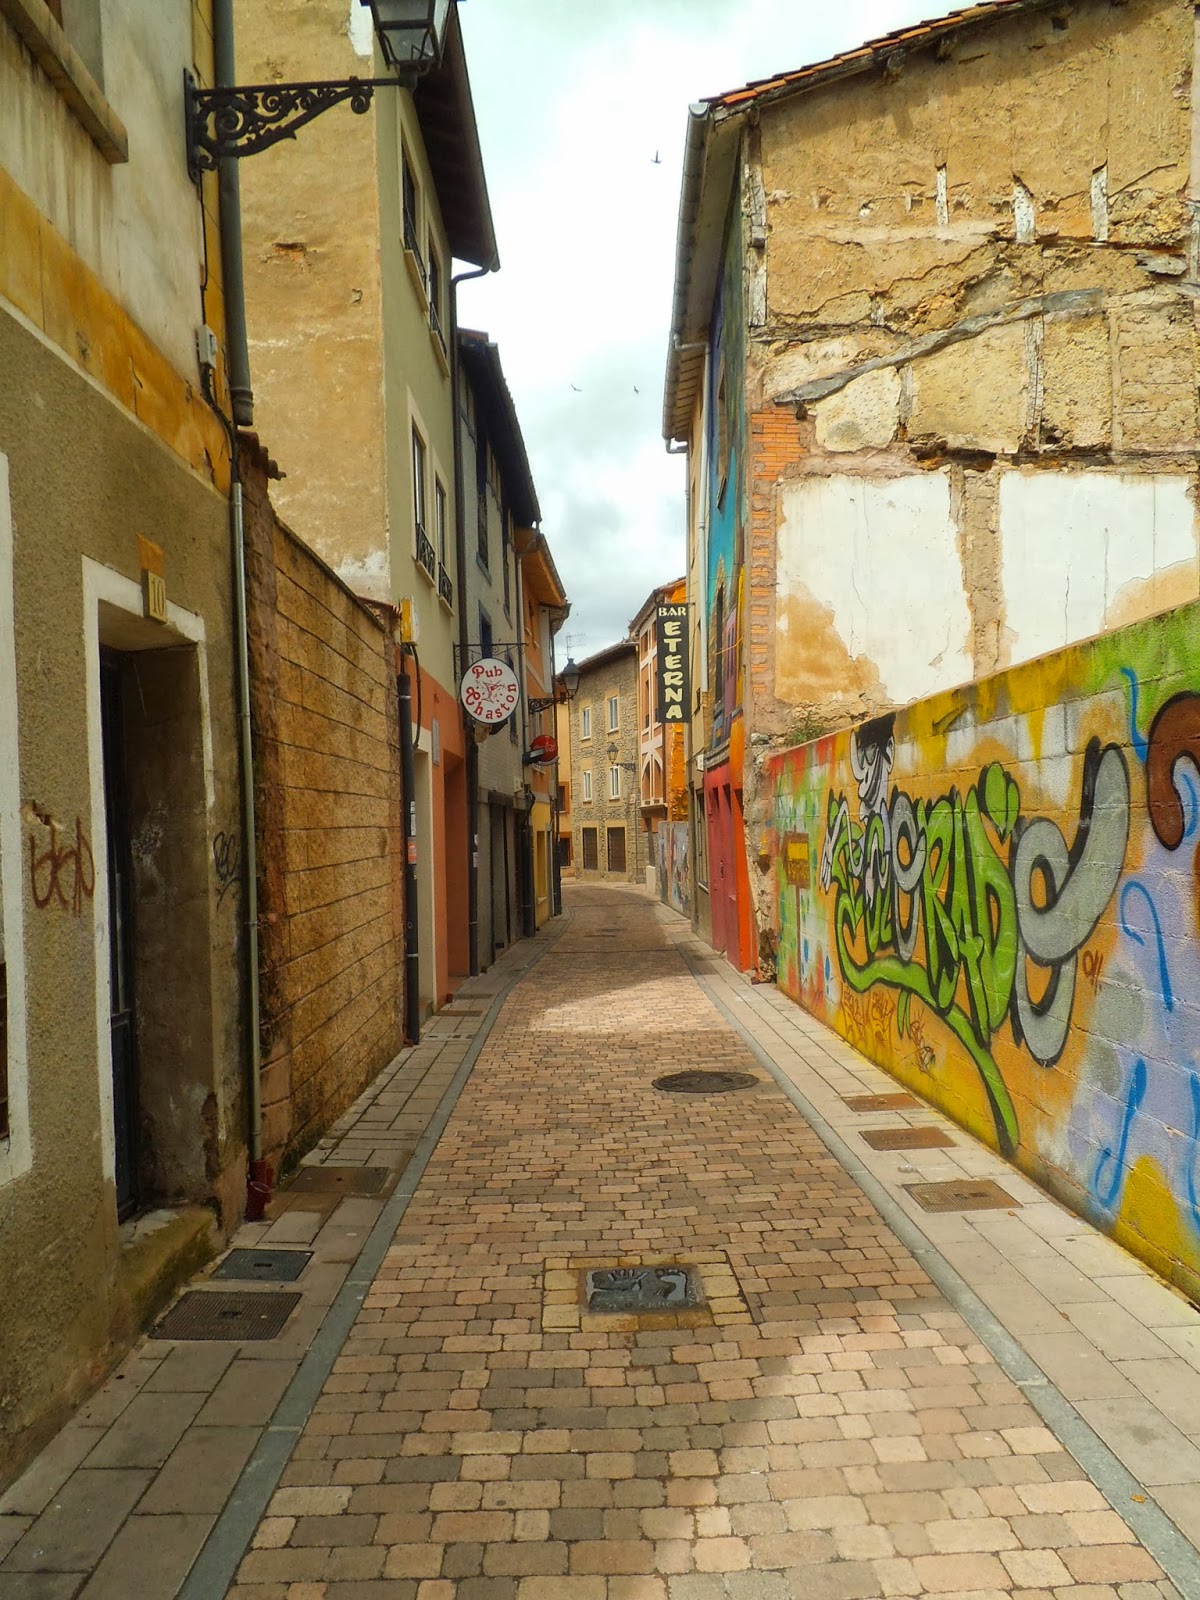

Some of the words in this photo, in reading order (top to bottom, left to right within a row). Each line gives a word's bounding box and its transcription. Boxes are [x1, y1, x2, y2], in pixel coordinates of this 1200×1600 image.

[151, 578, 165, 617] 10
[658, 606, 687, 617] BAR
[472, 665, 503, 679] Pub
[663, 621, 684, 719] ETERNA
[466, 683, 517, 720] Chaston
